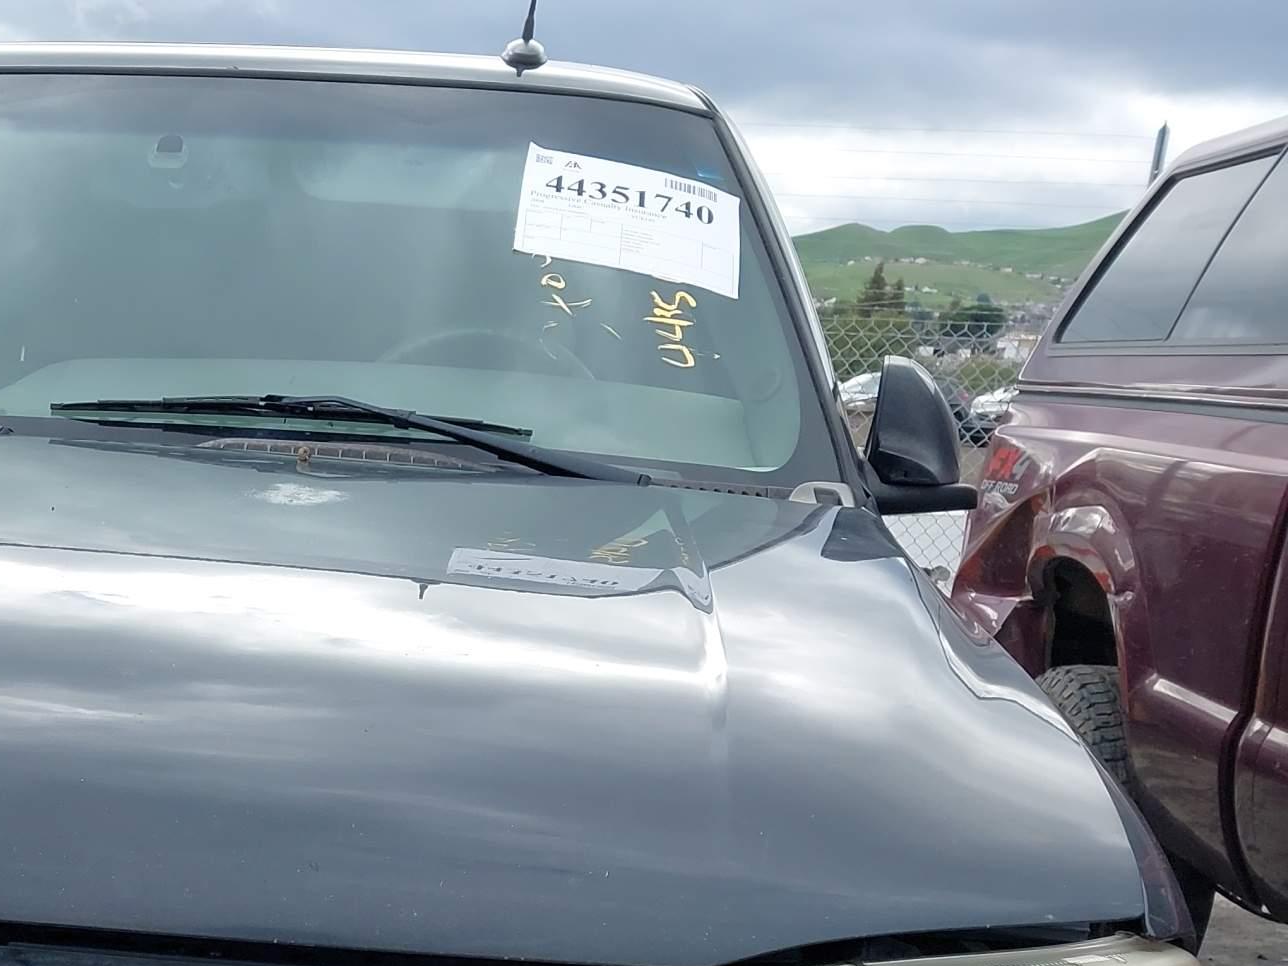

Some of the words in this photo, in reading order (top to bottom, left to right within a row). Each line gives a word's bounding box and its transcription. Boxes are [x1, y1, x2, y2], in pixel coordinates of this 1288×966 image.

[530, 190, 582, 204] Progressive
[545, 175, 714, 225] 44351740
[986, 447, 1031, 480] FX4
[995, 480, 1019, 496] ROAD
